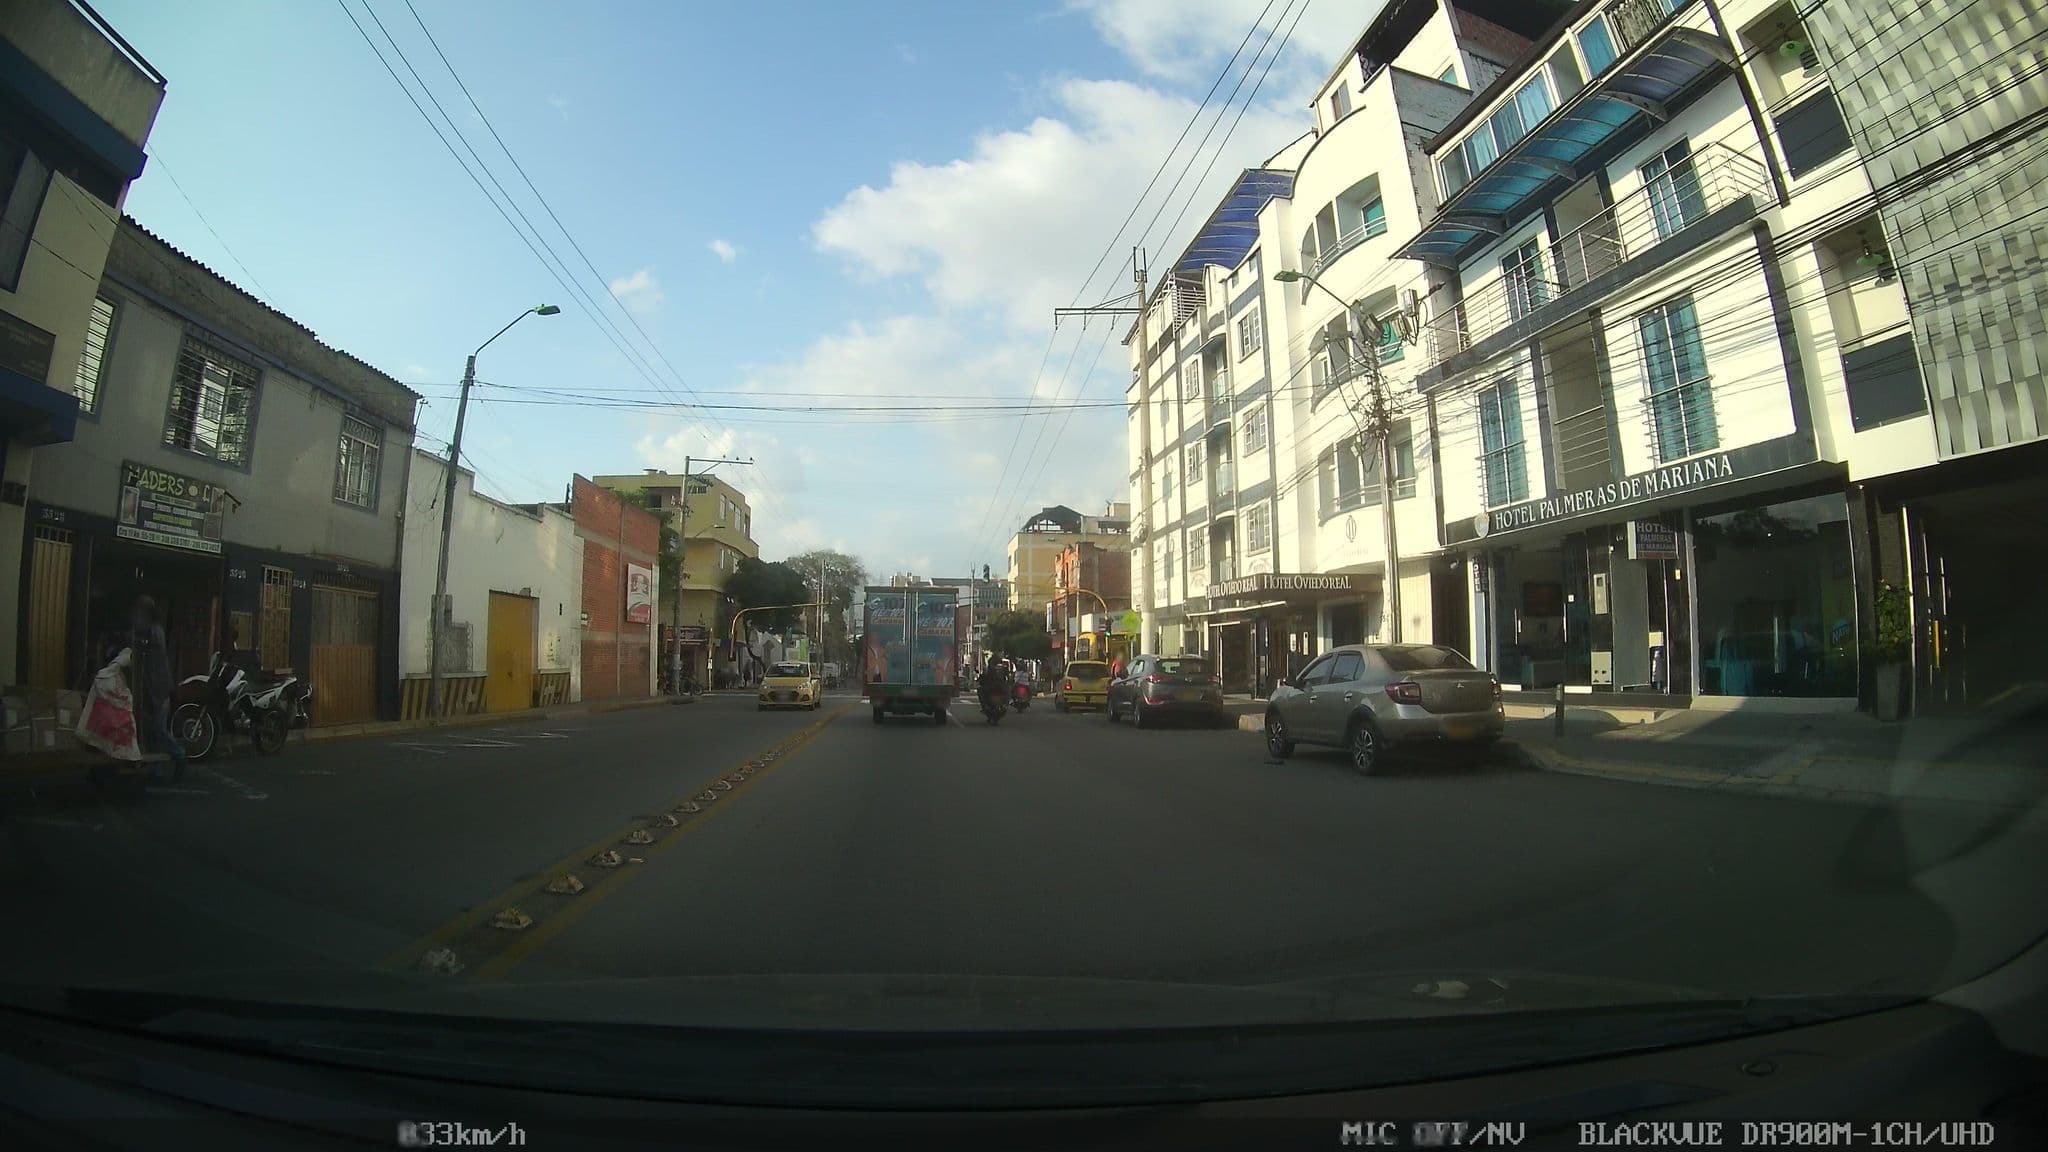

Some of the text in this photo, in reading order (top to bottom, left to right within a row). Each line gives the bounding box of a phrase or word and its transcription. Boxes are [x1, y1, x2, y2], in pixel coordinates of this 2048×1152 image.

[1495, 455, 1734, 530] HOTEL PALMERAS DE MARIANA
[1636, 522, 1673, 533] HOTEL
[1205, 576, 1258, 599] HOTEL OVIEDO REAL
[1263, 575, 1351, 589] HOTEL OVIEDO REAL
